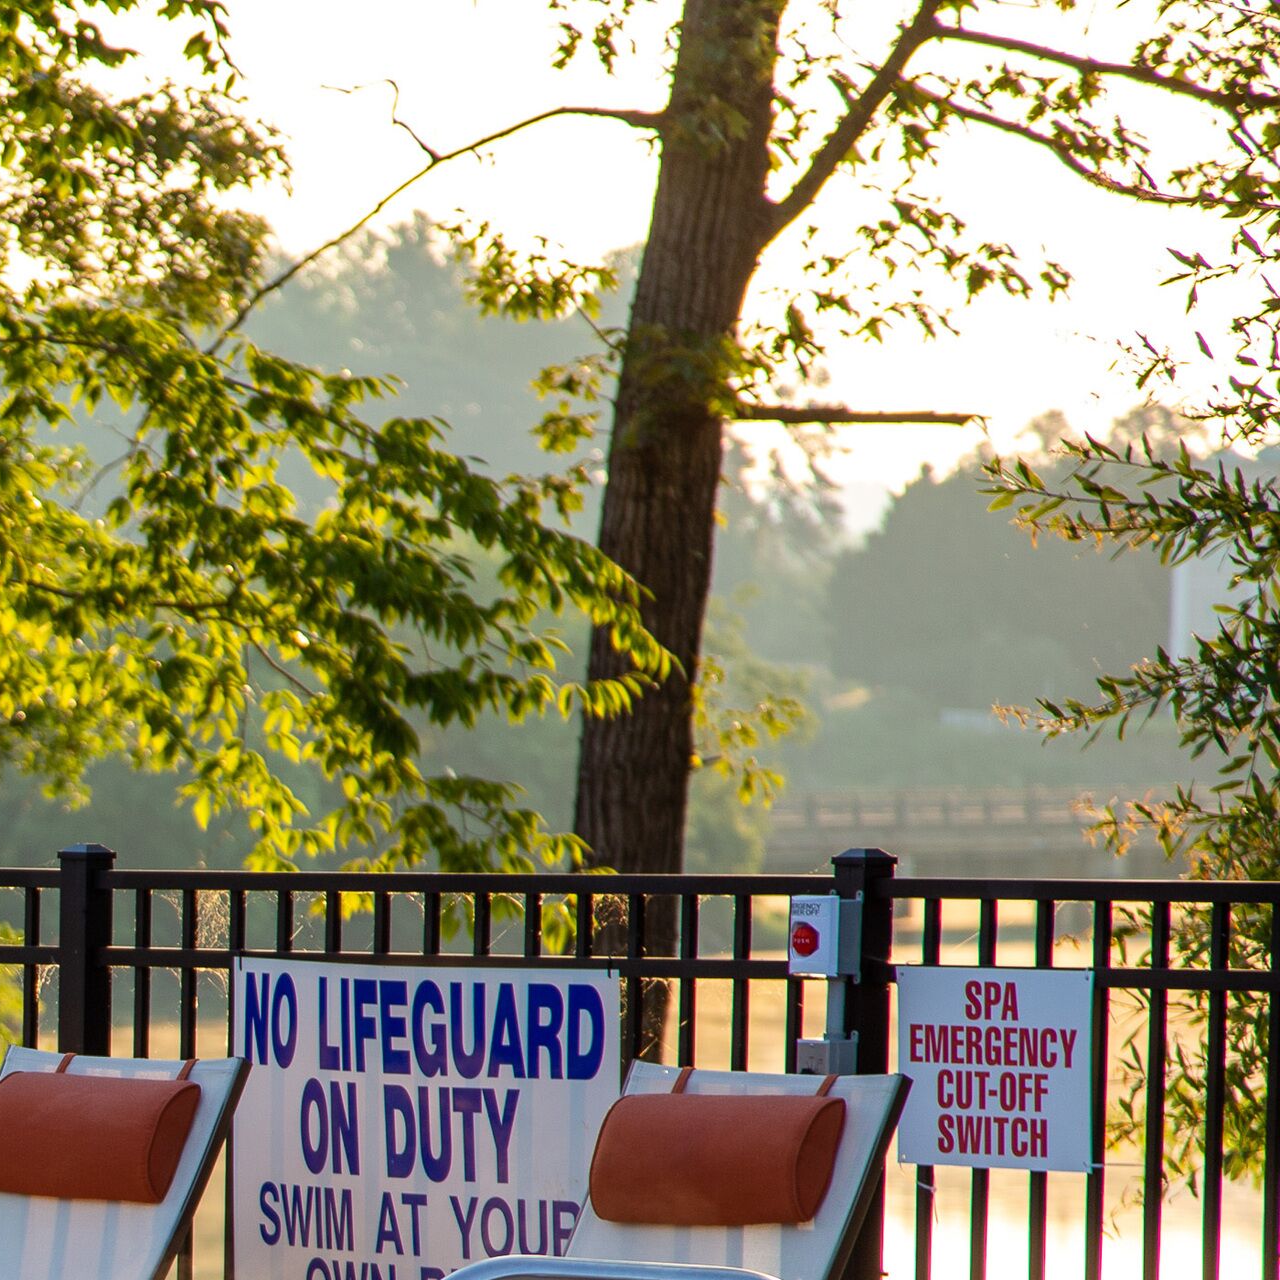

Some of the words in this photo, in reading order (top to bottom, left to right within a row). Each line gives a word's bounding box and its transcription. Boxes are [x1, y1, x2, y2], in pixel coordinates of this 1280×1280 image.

[965, 980, 1019, 1021] SPA
[244, 972, 298, 1069] NO
[319, 977, 605, 1081] LIFEGUARD
[909, 1024, 1078, 1068] EMERGENCY
[937, 1069, 1049, 1112] CUT-OFF
[300, 1077, 360, 1176] ON
[383, 1084, 521, 1184] DUTY
[938, 1114, 1049, 1158] SWITCH
[259, 1181, 355, 1251] SWIM
[376, 1191, 428, 1257] AT
[449, 1195, 581, 1260] YOUR
